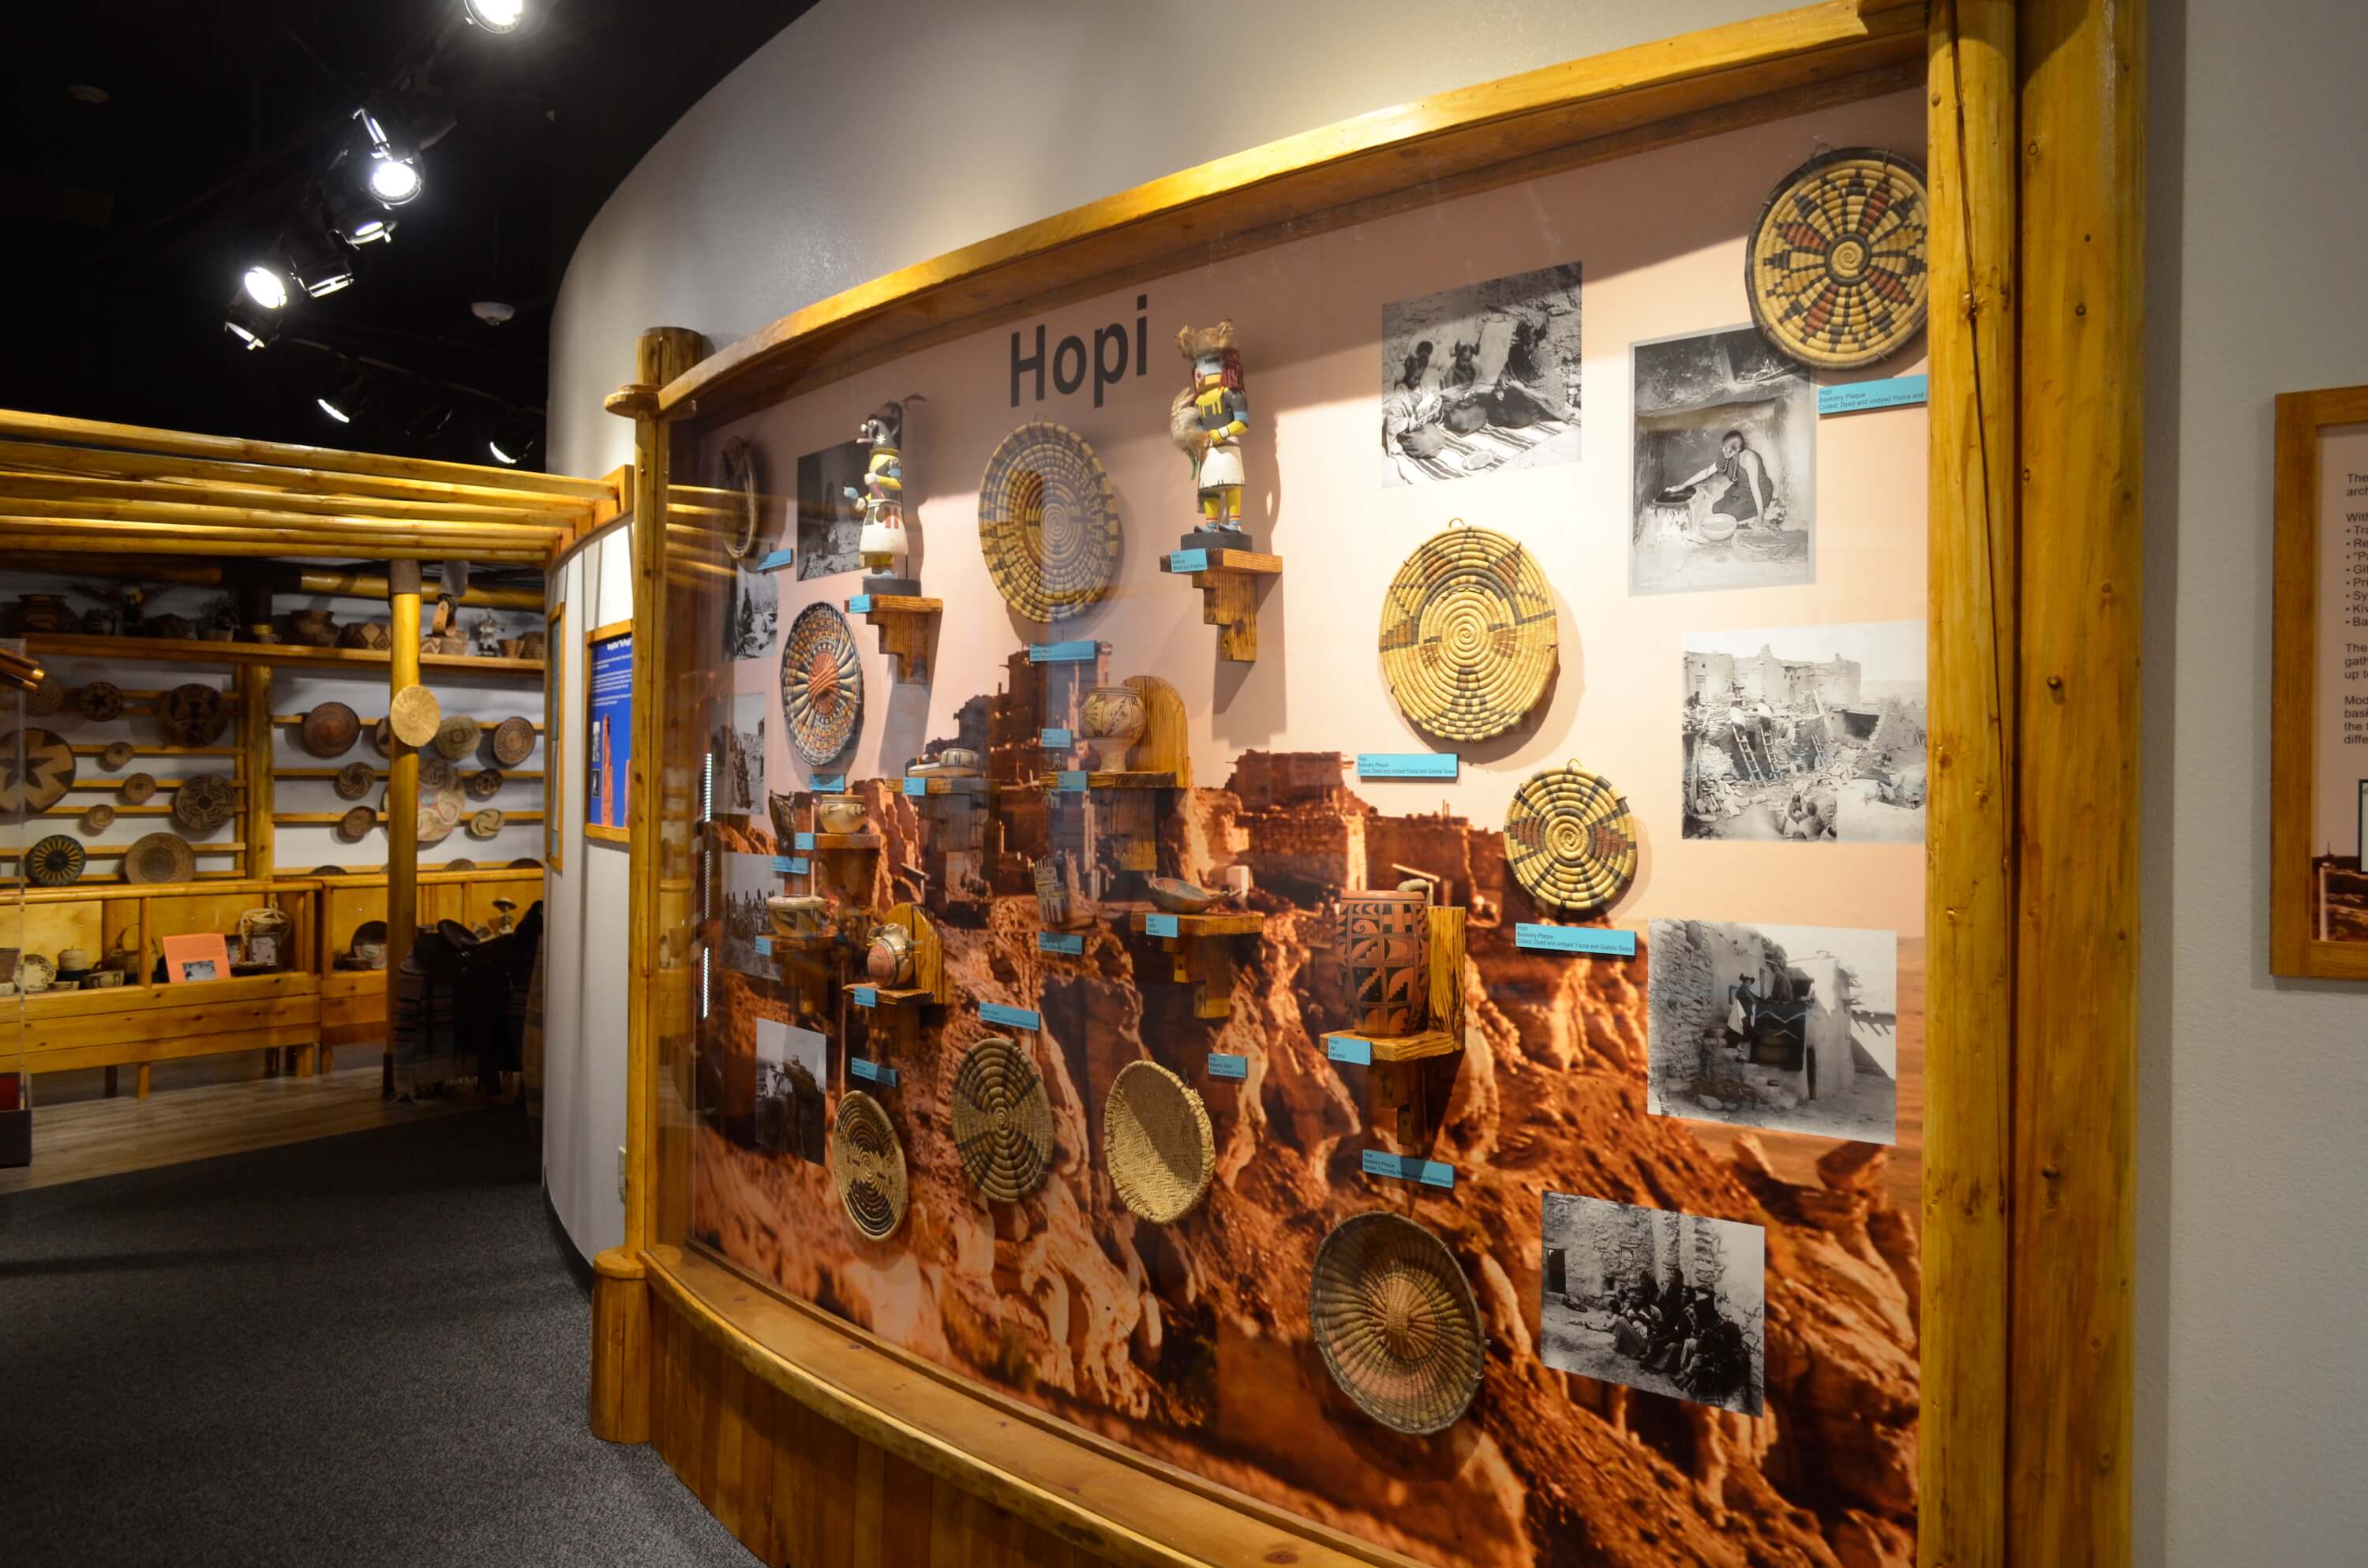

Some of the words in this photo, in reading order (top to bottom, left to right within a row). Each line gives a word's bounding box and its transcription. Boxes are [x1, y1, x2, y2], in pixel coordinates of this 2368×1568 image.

[1011, 294, 1147, 408] Hopi
[2346, 473, 2368, 483] The
[2345, 643, 2367, 653] The
[2344, 671, 2359, 681] up
[2344, 721, 2362, 732] the
